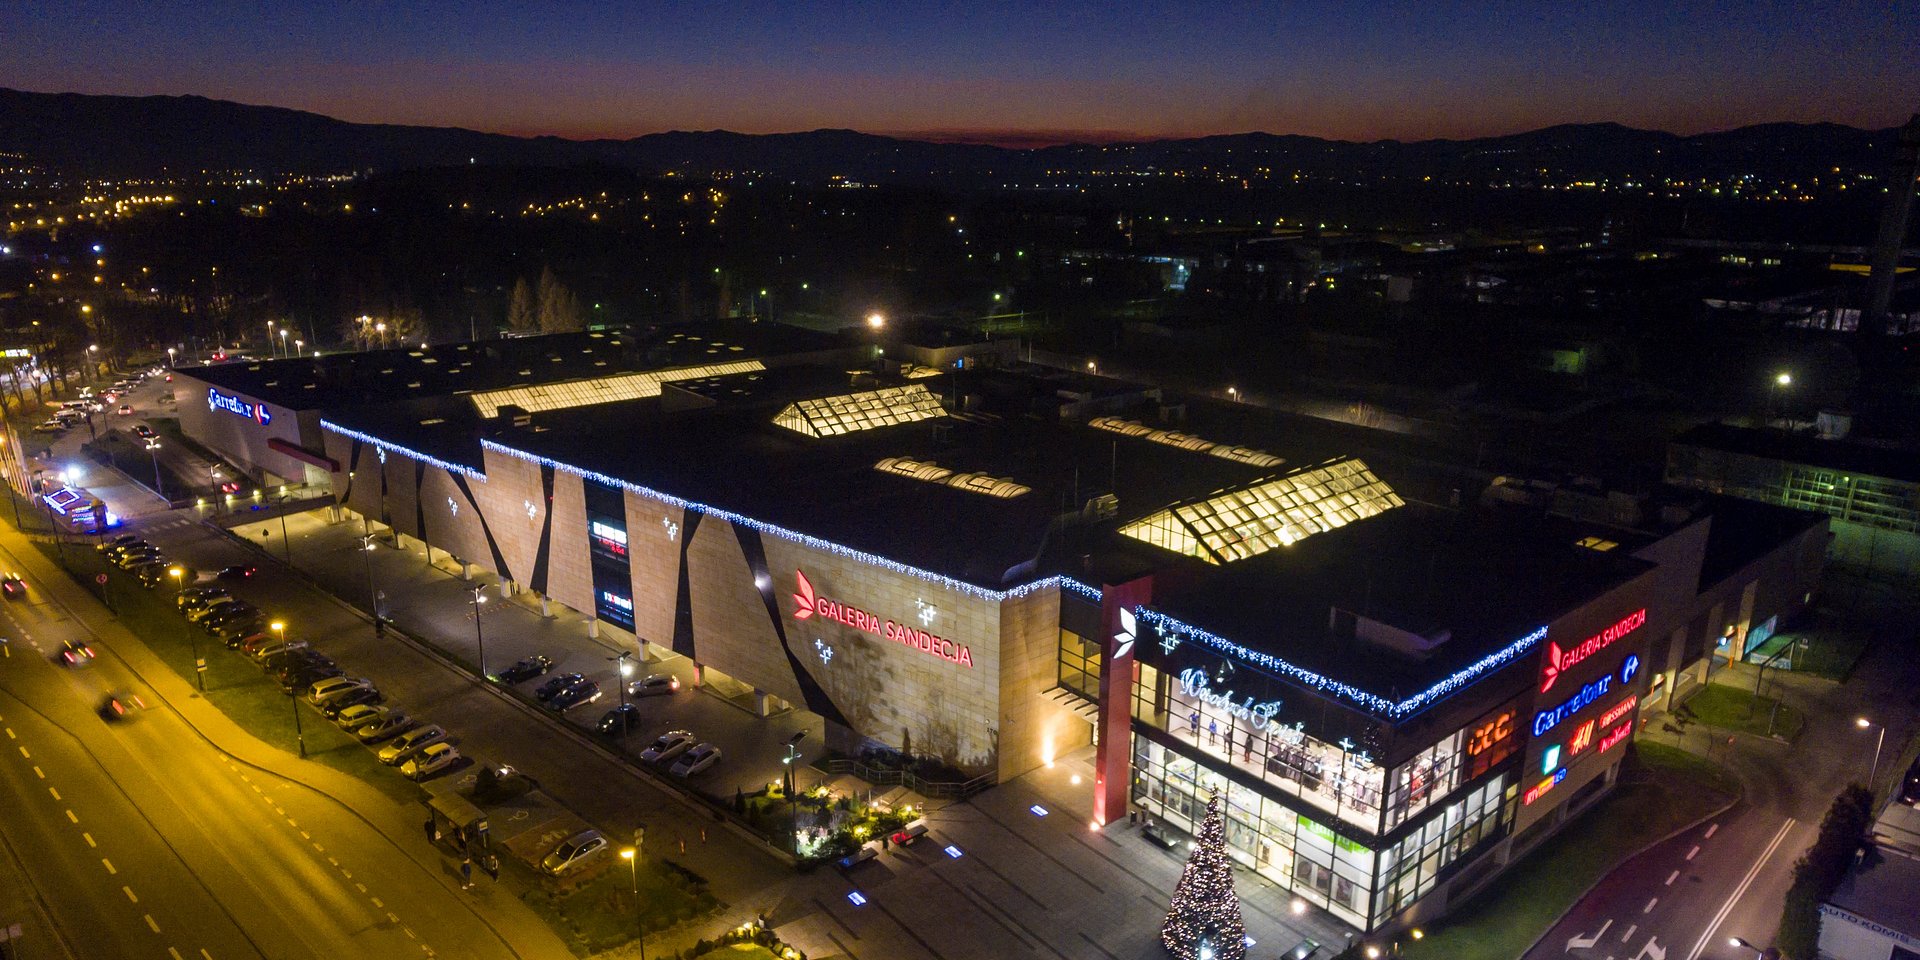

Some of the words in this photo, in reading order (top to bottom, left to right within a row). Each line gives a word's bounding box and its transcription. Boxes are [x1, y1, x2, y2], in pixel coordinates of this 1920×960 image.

[818, 598, 882, 636] GALERIA
[885, 620, 973, 668] SANDECJA
[1561, 634, 1601, 672] GALERIA
[1602, 608, 1646, 647] SANDECJA
[1533, 674, 1612, 737] Carrefour
[1599, 695, 1637, 729] ROSSMANN
[1818, 904, 1858, 924] AUTO
